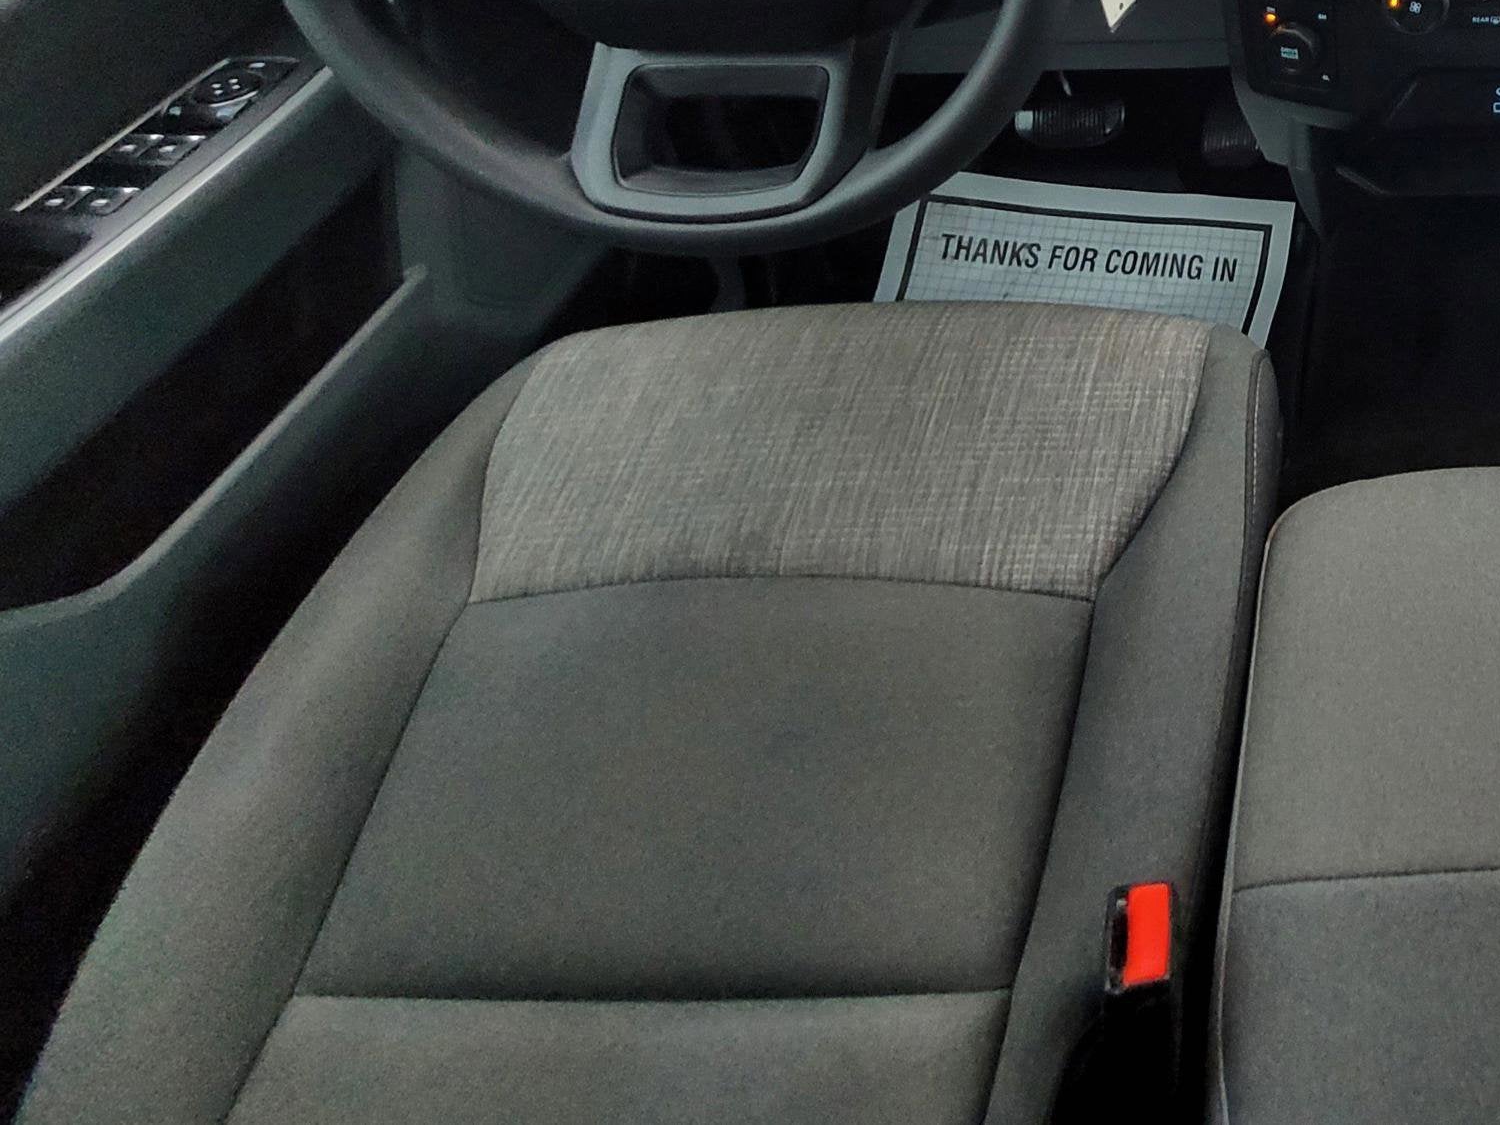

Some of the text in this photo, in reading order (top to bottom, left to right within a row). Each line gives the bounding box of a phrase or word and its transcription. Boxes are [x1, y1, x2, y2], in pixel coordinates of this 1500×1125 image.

[941, 233, 1238, 282] THANKS FOR COMING IN
